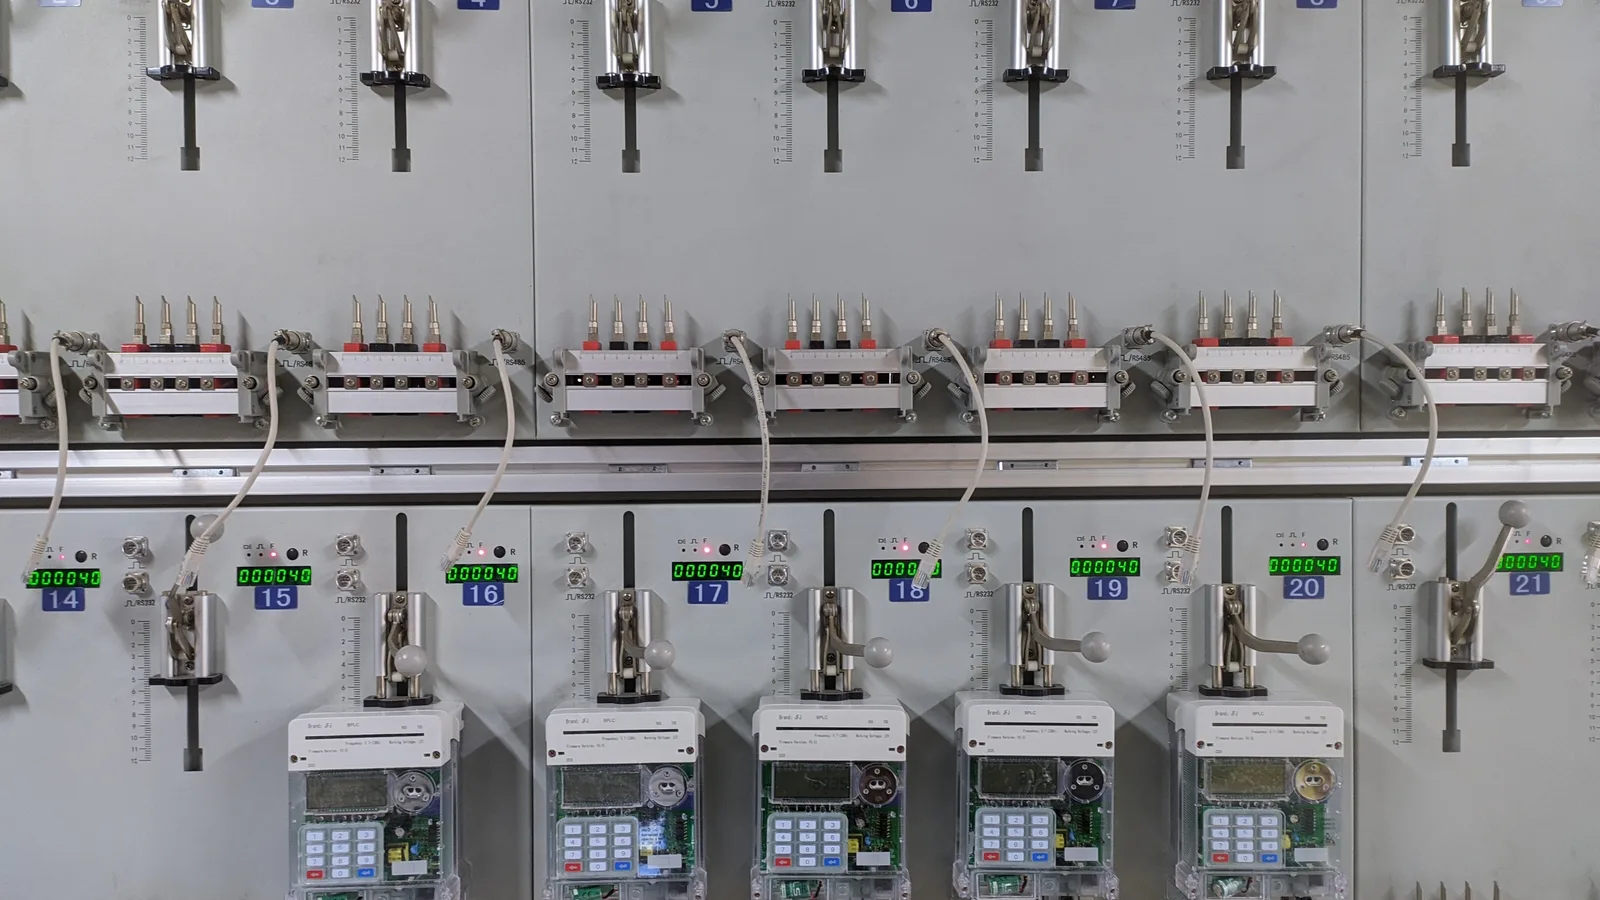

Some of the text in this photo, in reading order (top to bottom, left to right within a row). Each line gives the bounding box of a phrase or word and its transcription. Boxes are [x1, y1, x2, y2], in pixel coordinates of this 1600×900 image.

[447, 566, 518, 581] 000040
[674, 564, 743, 578] 000040
[872, 562, 940, 576] 00000
[1071, 560, 1138, 574] 000040
[1269, 558, 1338, 572] 000040
[29, 571, 101, 586] 000040
[239, 569, 311, 583] 000040
[1516, 575, 1540, 592] 21
[470, 585, 498, 603] 16
[695, 584, 722, 602] 17
[897, 582, 924, 599] 18
[1095, 580, 1122, 598] 19
[1290, 578, 1319, 596] 20
[49, 590, 79, 609] 14
[262, 588, 291, 607] 15
